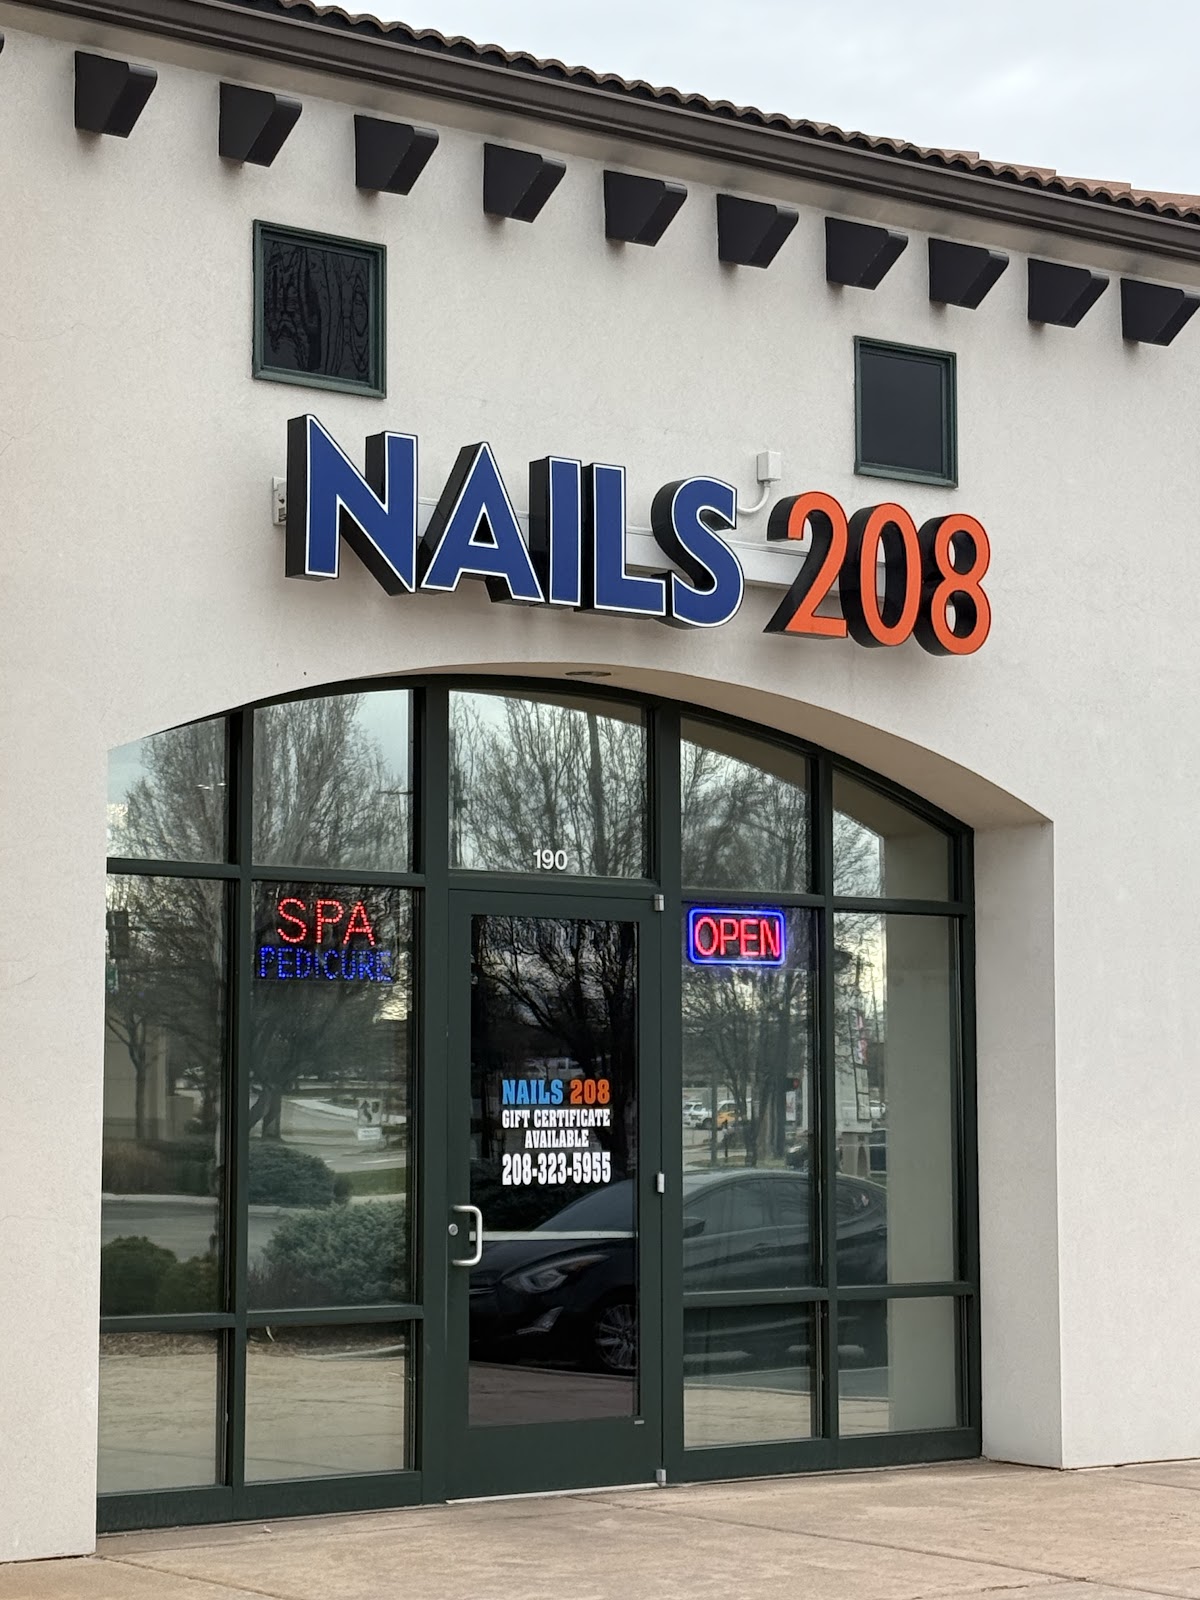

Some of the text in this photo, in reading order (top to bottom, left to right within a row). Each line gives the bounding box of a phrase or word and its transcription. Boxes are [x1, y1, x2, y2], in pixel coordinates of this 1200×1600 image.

[303, 413, 991, 656] NAILS 208
[532, 848, 568, 871] 190
[277, 897, 376, 946] SPA
[693, 916, 781, 957] OPEN
[257, 944, 393, 982] PEDICURE
[502, 1078, 610, 1104] NAILS 208
[502, 1109, 611, 1128] GIFT CERTIFICATE
[524, 1129, 590, 1149] AVAILABLE
[502, 1151, 611, 1186] 208-323-5955
